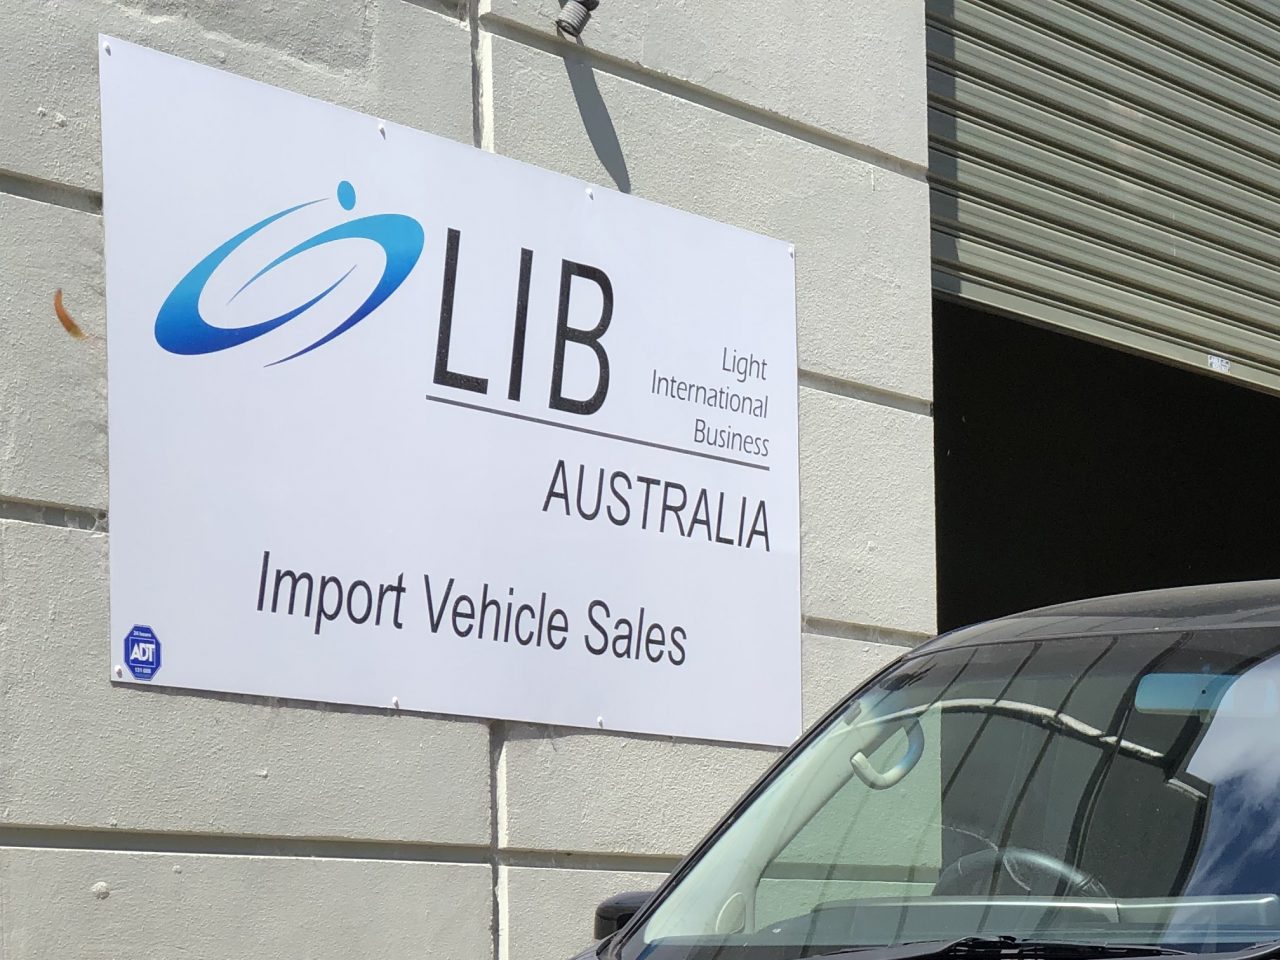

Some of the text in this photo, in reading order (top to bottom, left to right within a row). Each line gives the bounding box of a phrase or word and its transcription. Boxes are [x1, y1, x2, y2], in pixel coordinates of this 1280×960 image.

[432, 227, 614, 416] LIB
[722, 346, 768, 383] Light
[651, 369, 768, 419] International
[693, 418, 770, 457] Business
[542, 459, 771, 552] AUSTRALIA
[256, 550, 687, 666] Import Vehicle Sales
[130, 642, 155, 662] ADT
